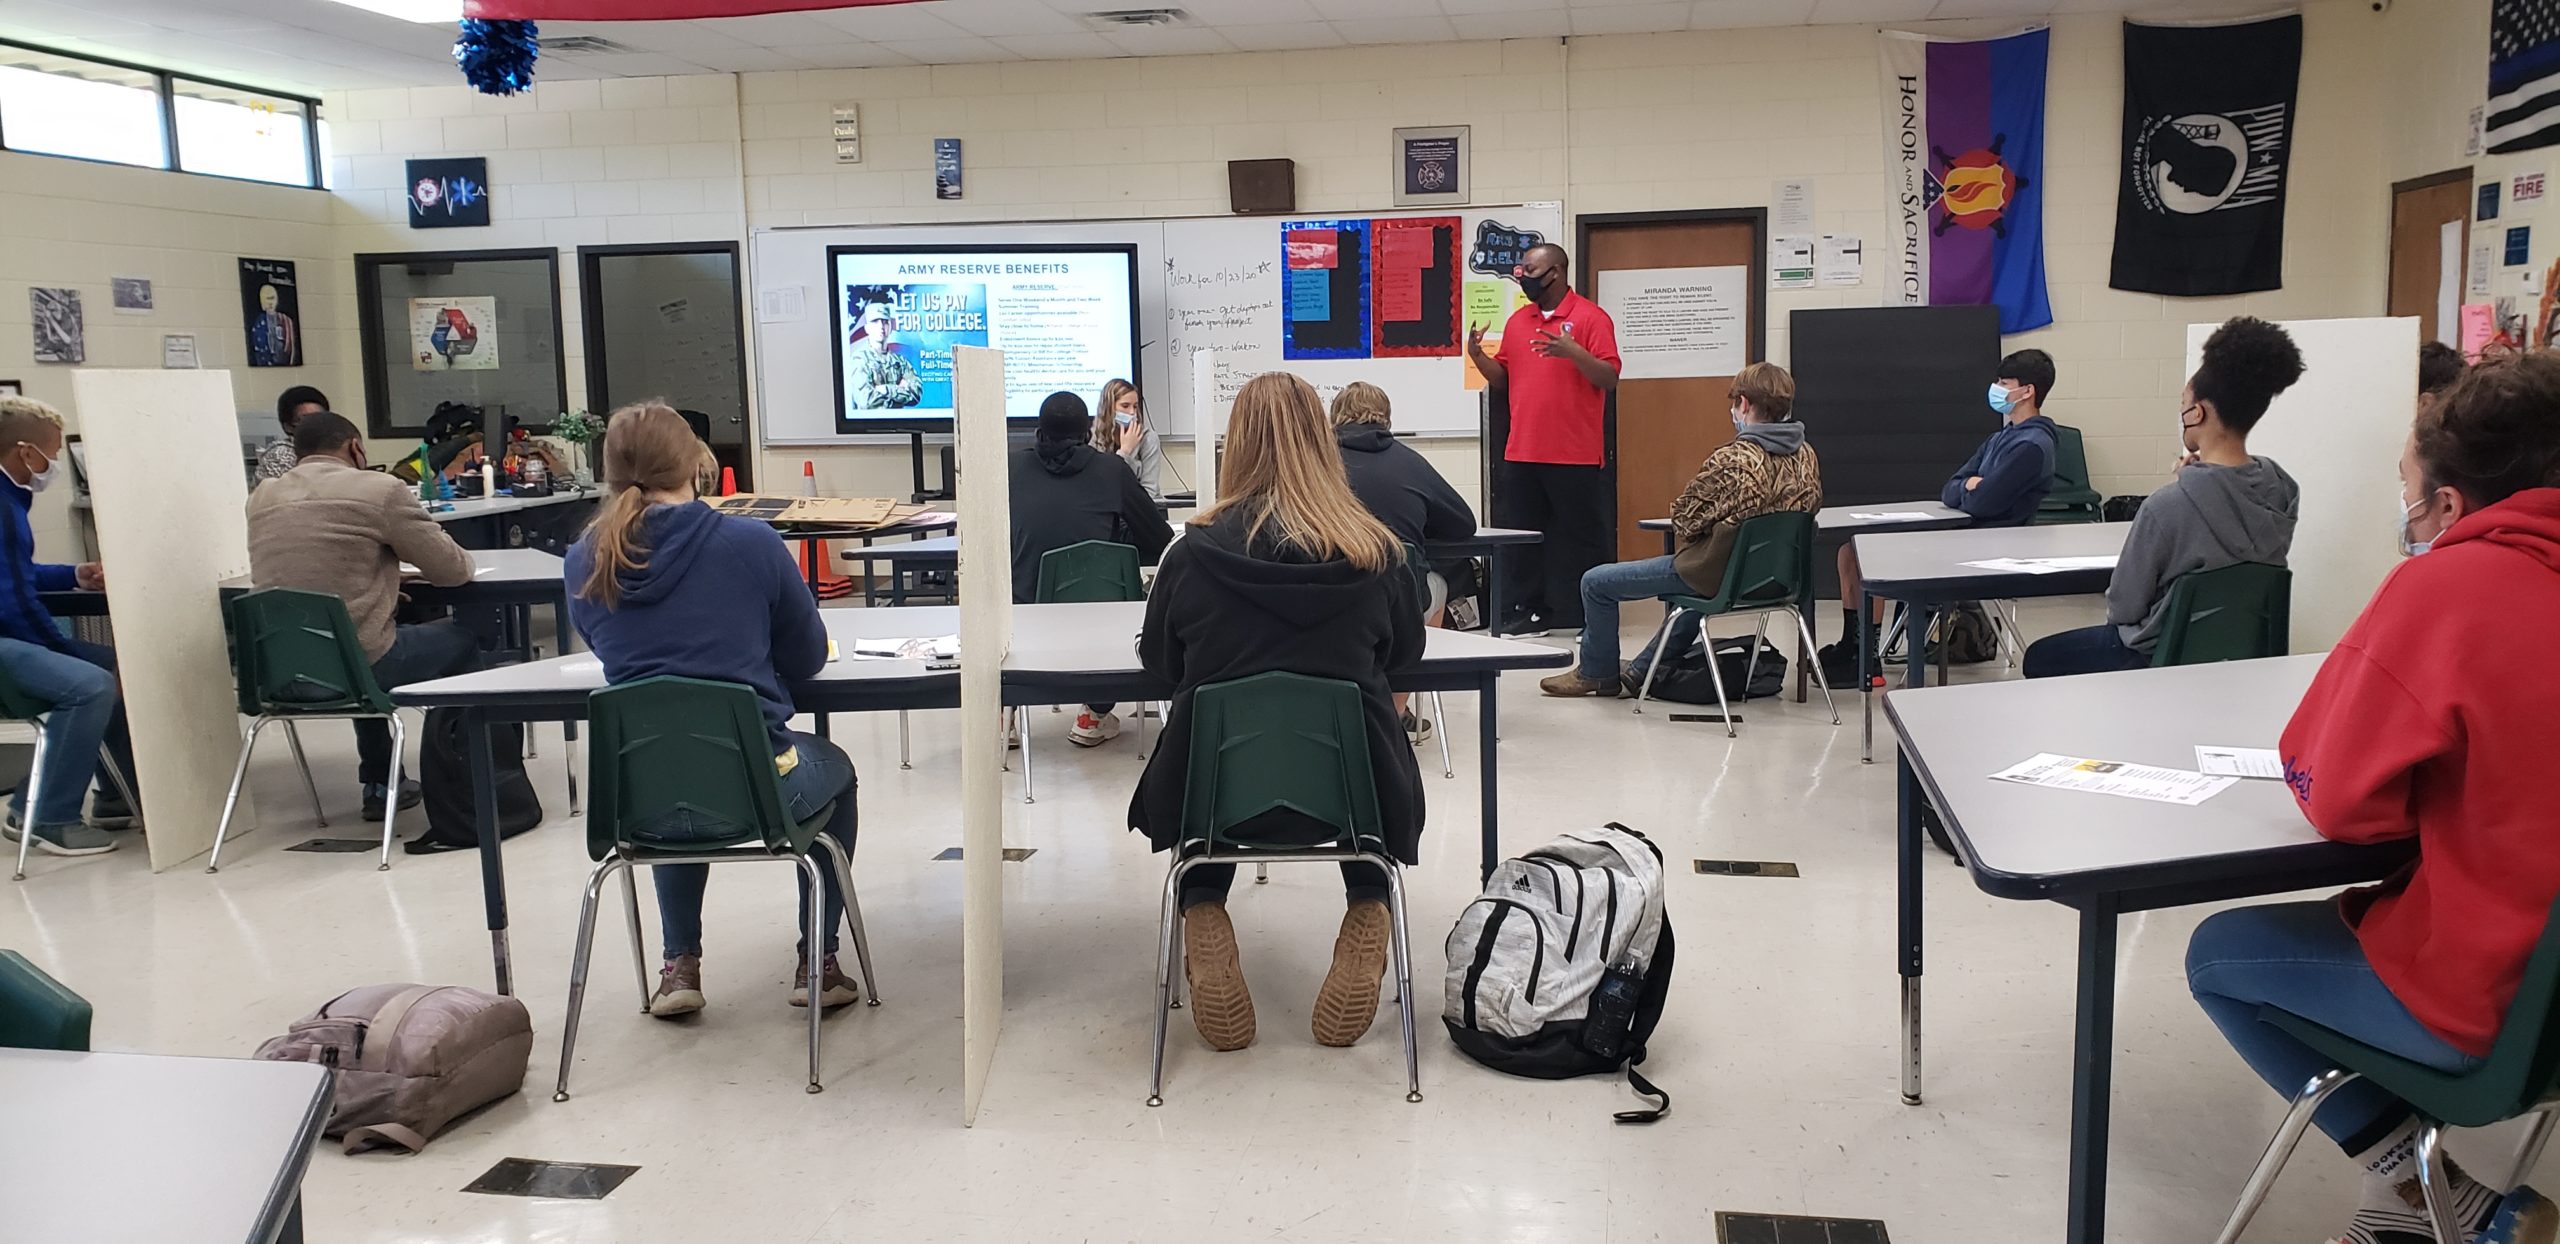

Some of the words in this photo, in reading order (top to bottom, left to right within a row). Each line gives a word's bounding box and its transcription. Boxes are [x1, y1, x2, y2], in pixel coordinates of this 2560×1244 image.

[1899, 76, 1917, 163] HONOR
[2221, 102, 2286, 151] POW
[2133, 146, 2143, 162] NOT
[1905, 167, 1913, 191] AND
[2132, 164, 2153, 210] FORGOTTEN
[2213, 164, 2280, 211] MIA
[2513, 180, 2544, 197] FIRE
[1487, 250, 1525, 265] KELL
[1901, 192, 1919, 303] SACRIFICE
[898, 264, 935, 274] ARMY
[940, 264, 1000, 274] RESERVE
[1006, 263, 1069, 274] BENEFITS
[1170, 270, 1197, 287] Work
[1197, 275, 1212, 289] for
[1215, 265, 1257, 287] 10/23/20
[1644, 287, 1677, 295] MIRANDA
[1679, 285, 1713, 293] WARNING
[895, 293, 918, 312] LET
[922, 293, 941, 312] US
[946, 294, 968, 312] PAY
[895, 313, 922, 332] FOR
[926, 312, 987, 332] COLLEGE.
[1512, 884, 1532, 894] adidas
